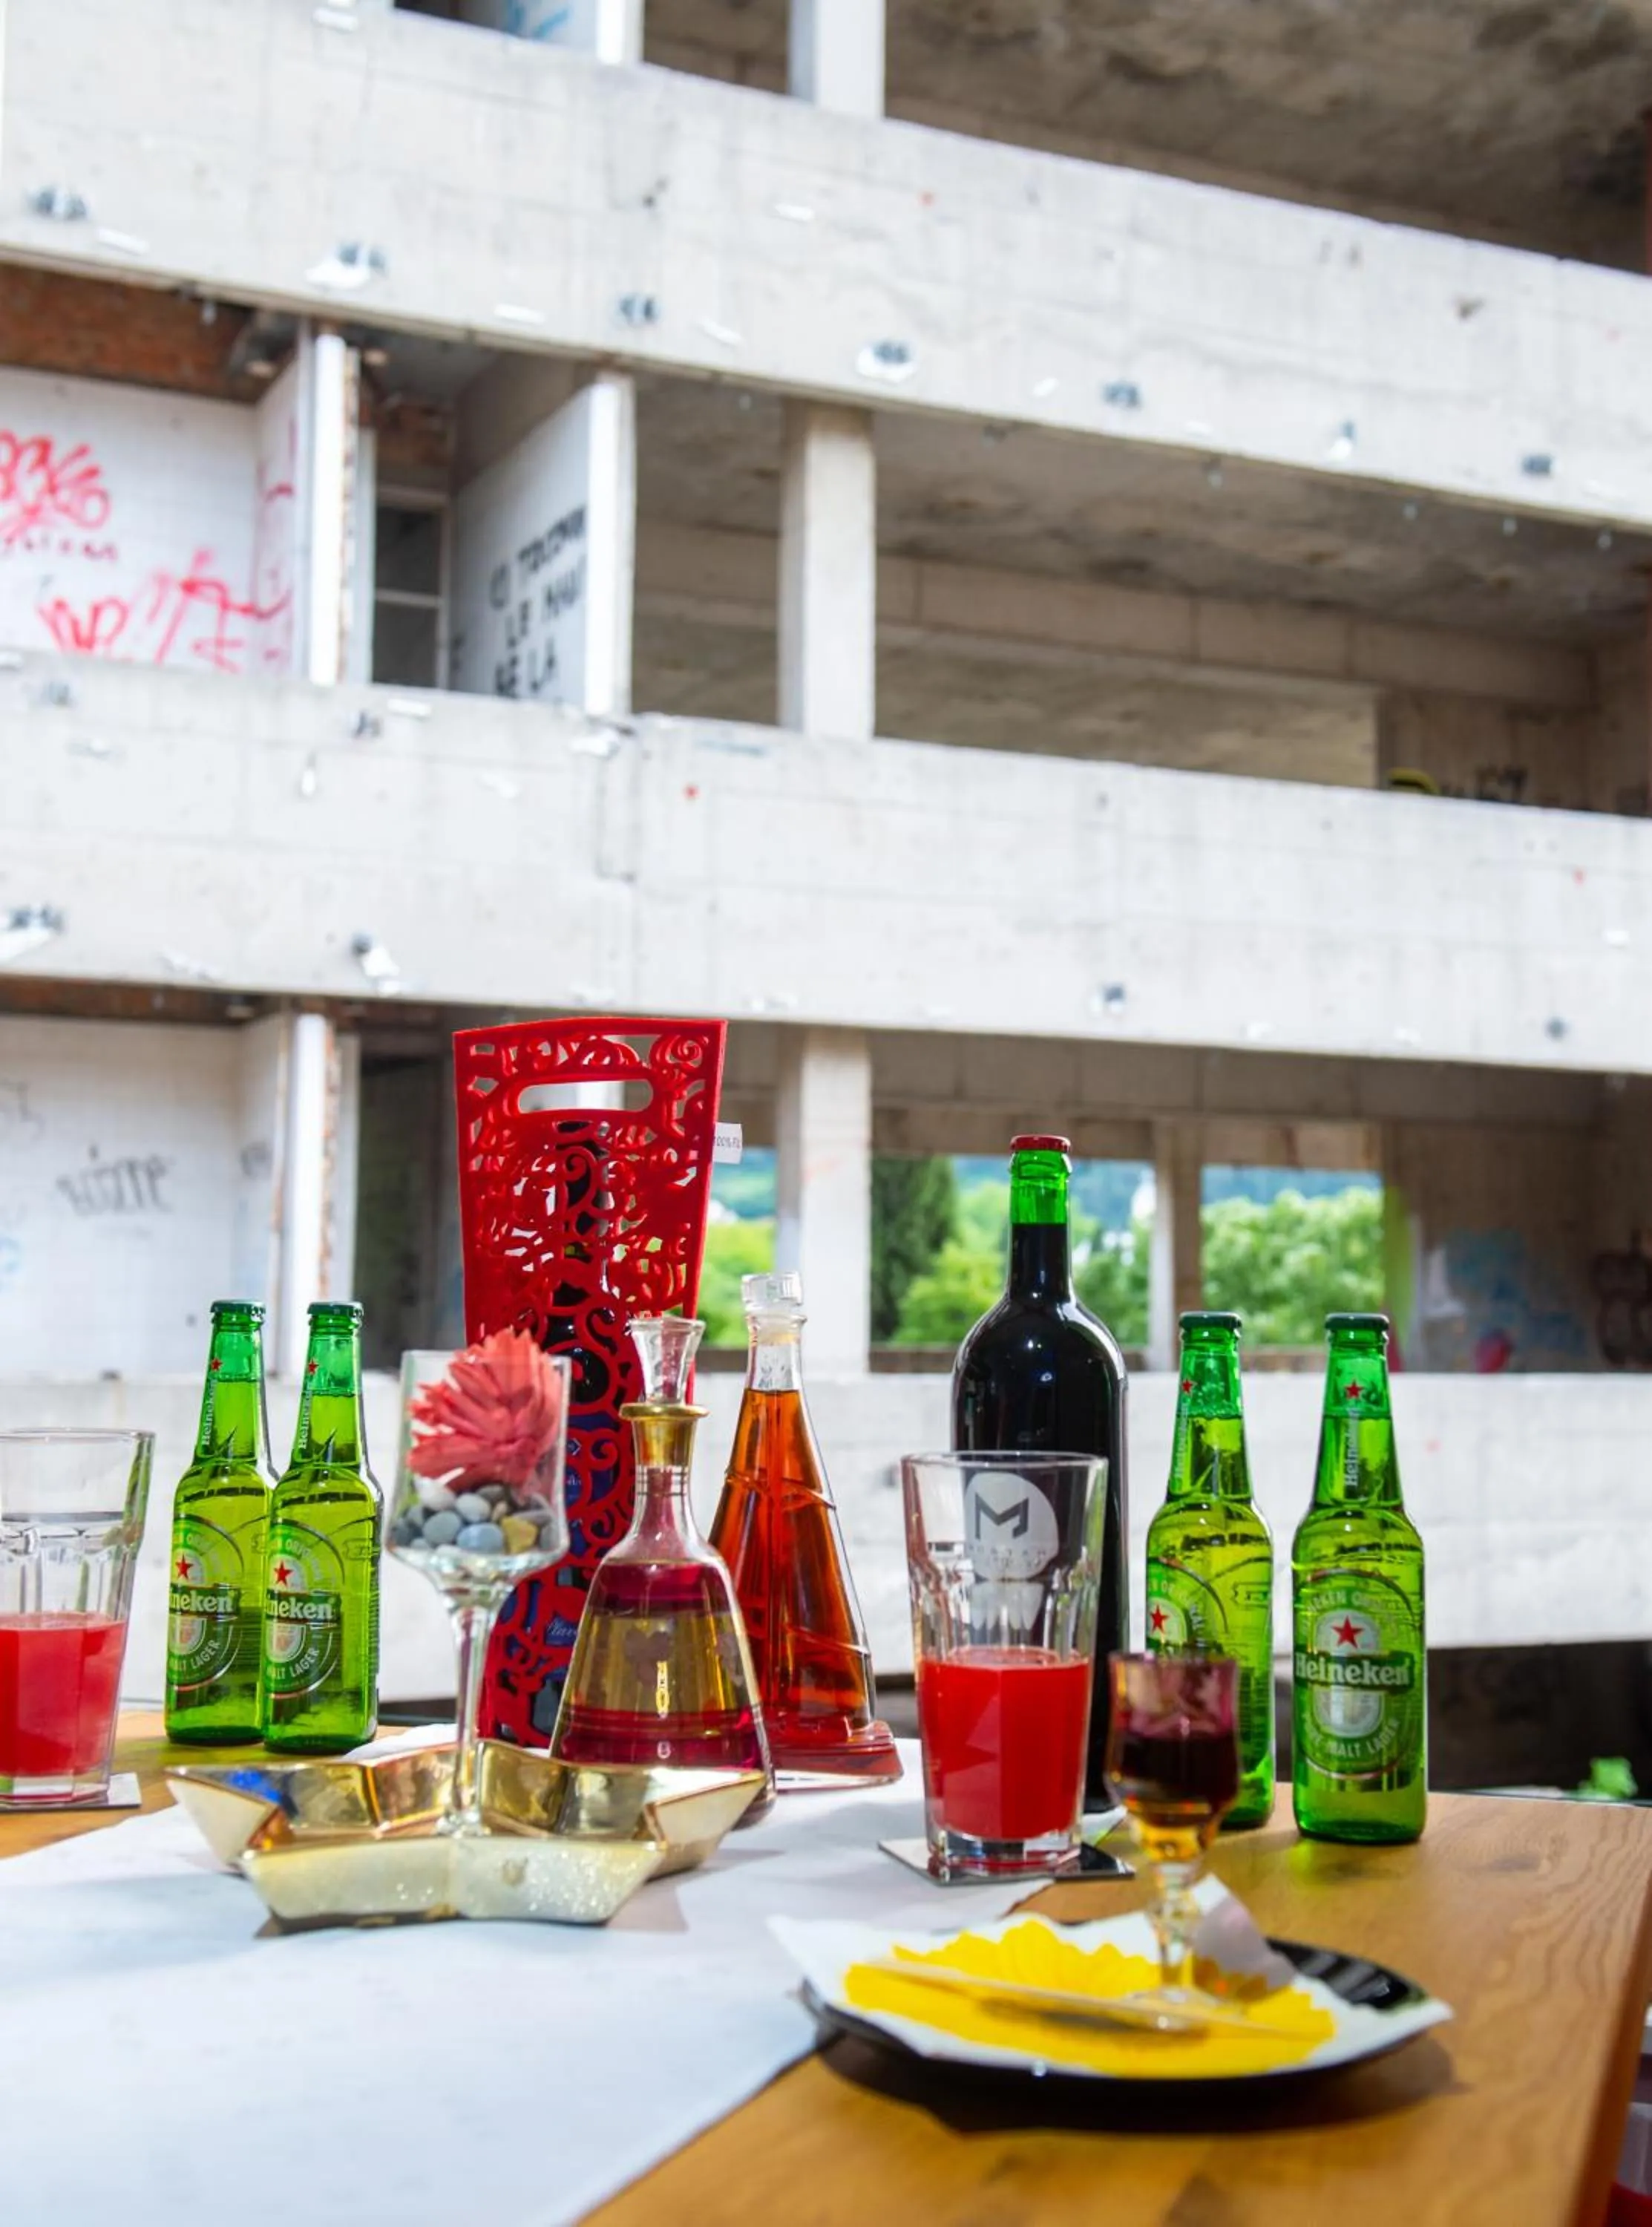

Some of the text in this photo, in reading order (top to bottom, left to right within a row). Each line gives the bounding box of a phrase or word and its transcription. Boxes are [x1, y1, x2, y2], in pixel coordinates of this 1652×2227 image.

[170, 1590, 232, 1612] neken
[266, 1595, 332, 1620] neken
[191, 1639, 220, 1670] LAGER
[289, 1646, 319, 1678] LAGER
[1296, 1652, 1409, 1685] Heineken
